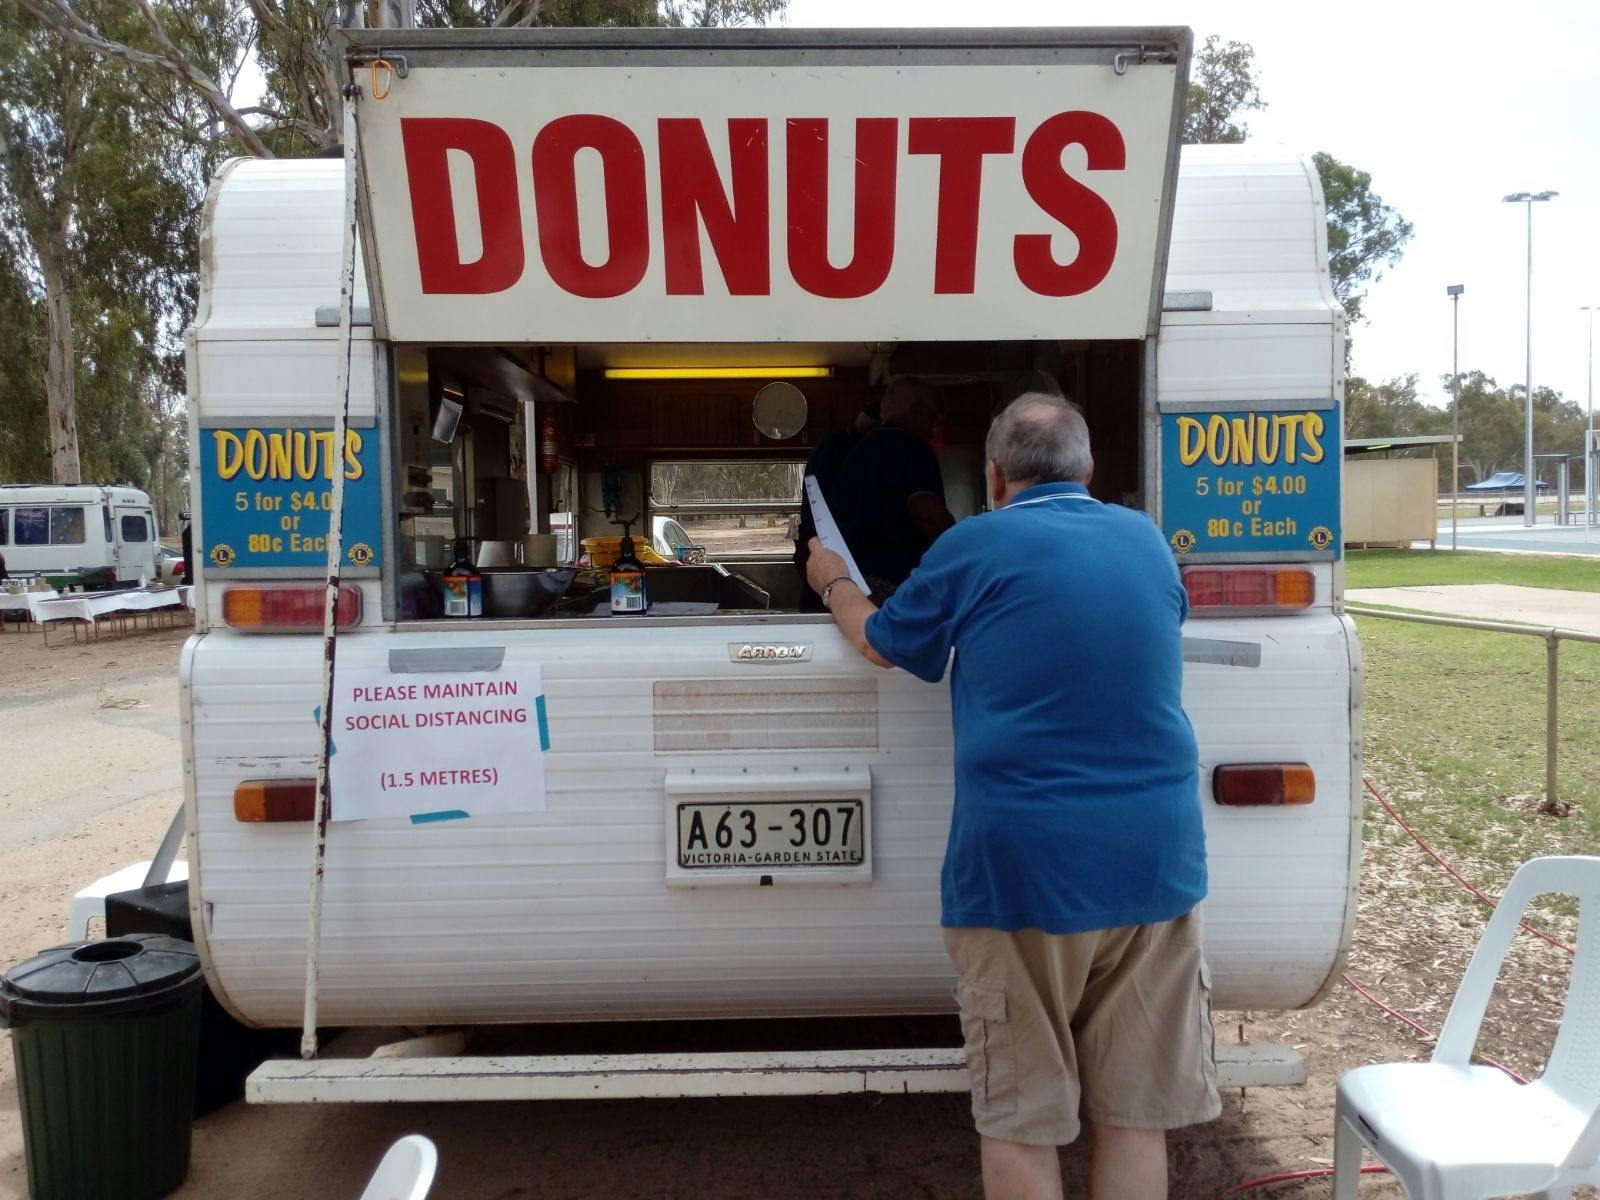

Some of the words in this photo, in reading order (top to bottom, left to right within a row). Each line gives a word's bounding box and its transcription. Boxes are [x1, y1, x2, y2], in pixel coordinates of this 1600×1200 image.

[400, 110, 1126, 299] DONUTS
[1176, 411, 1325, 466] DONUTS
[213, 428, 364, 480] DONUTS
[1196, 477, 1209, 496] 5
[1217, 477, 1244, 496] for
[1252, 475, 1306, 496] $4.00
[235, 492, 248, 511] 5
[255, 492, 282, 511] for
[291, 490, 333, 512] $4.0
[1242, 500, 1262, 515] or
[280, 515, 300, 531] or
[1251, 517, 1297, 536] Each
[353, 685, 417, 702] PLEASE
[423, 681, 518, 699] MAINTAIN
[345, 714, 410, 731] SOCIAL
[415, 708, 527, 728] DISTANCING
[380, 772, 414, 791] (1.5
[420, 767, 498, 787] METRES)
[687, 807, 855, 850] A63-307
[817, 850, 857, 862] STATE
